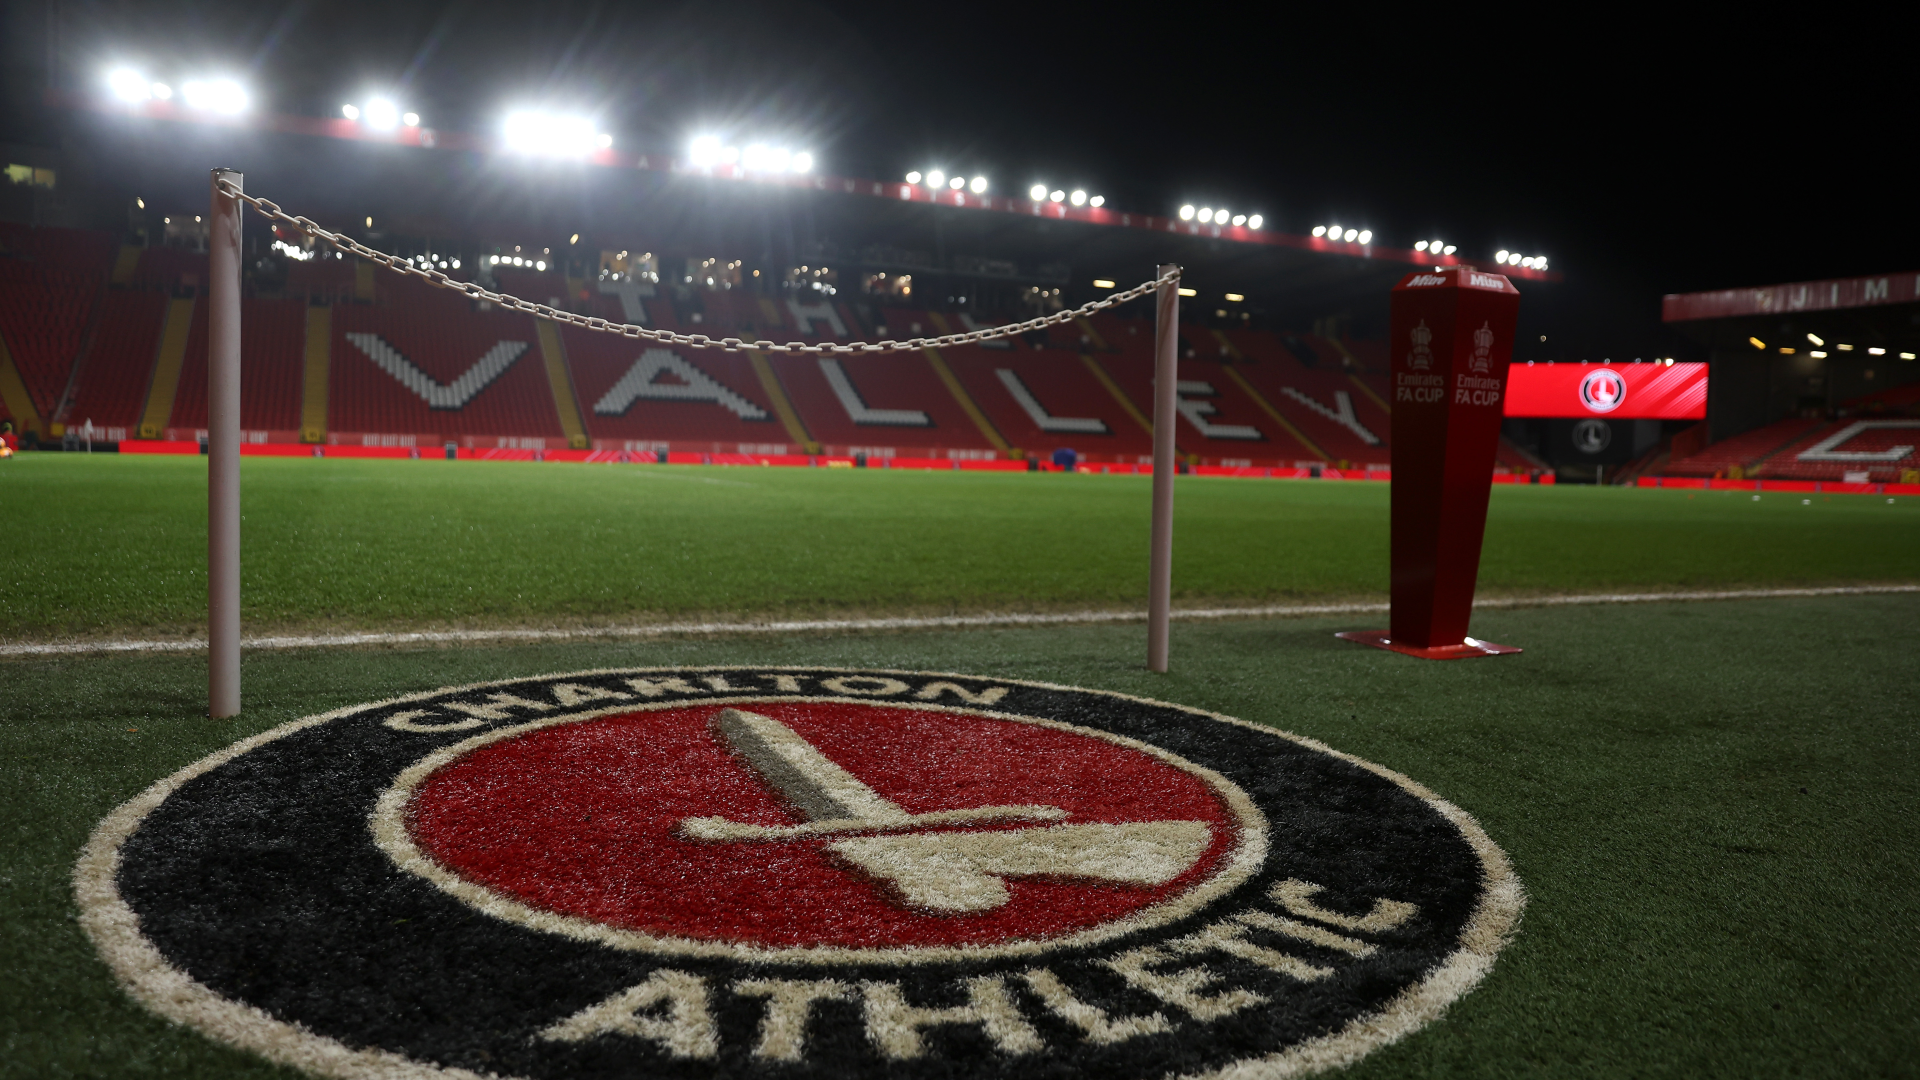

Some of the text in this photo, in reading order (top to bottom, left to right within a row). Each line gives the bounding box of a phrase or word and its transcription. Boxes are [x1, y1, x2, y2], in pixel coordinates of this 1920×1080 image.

[1121, 212, 1222, 238] STAND
[1406, 274, 1446, 288] Mitre
[1470, 273, 1504, 289] Mitre
[346, 332, 1382, 444] VALLEY
[1397, 372, 1444, 387] Emirates
[1457, 373, 1500, 390] Emirates
[1397, 387, 1444, 403] FA CUP
[1455, 388, 1500, 406] FA CUP
[384, 672, 1010, 734] CHARLTON
[536, 877, 1418, 1062] ATHLETIC
